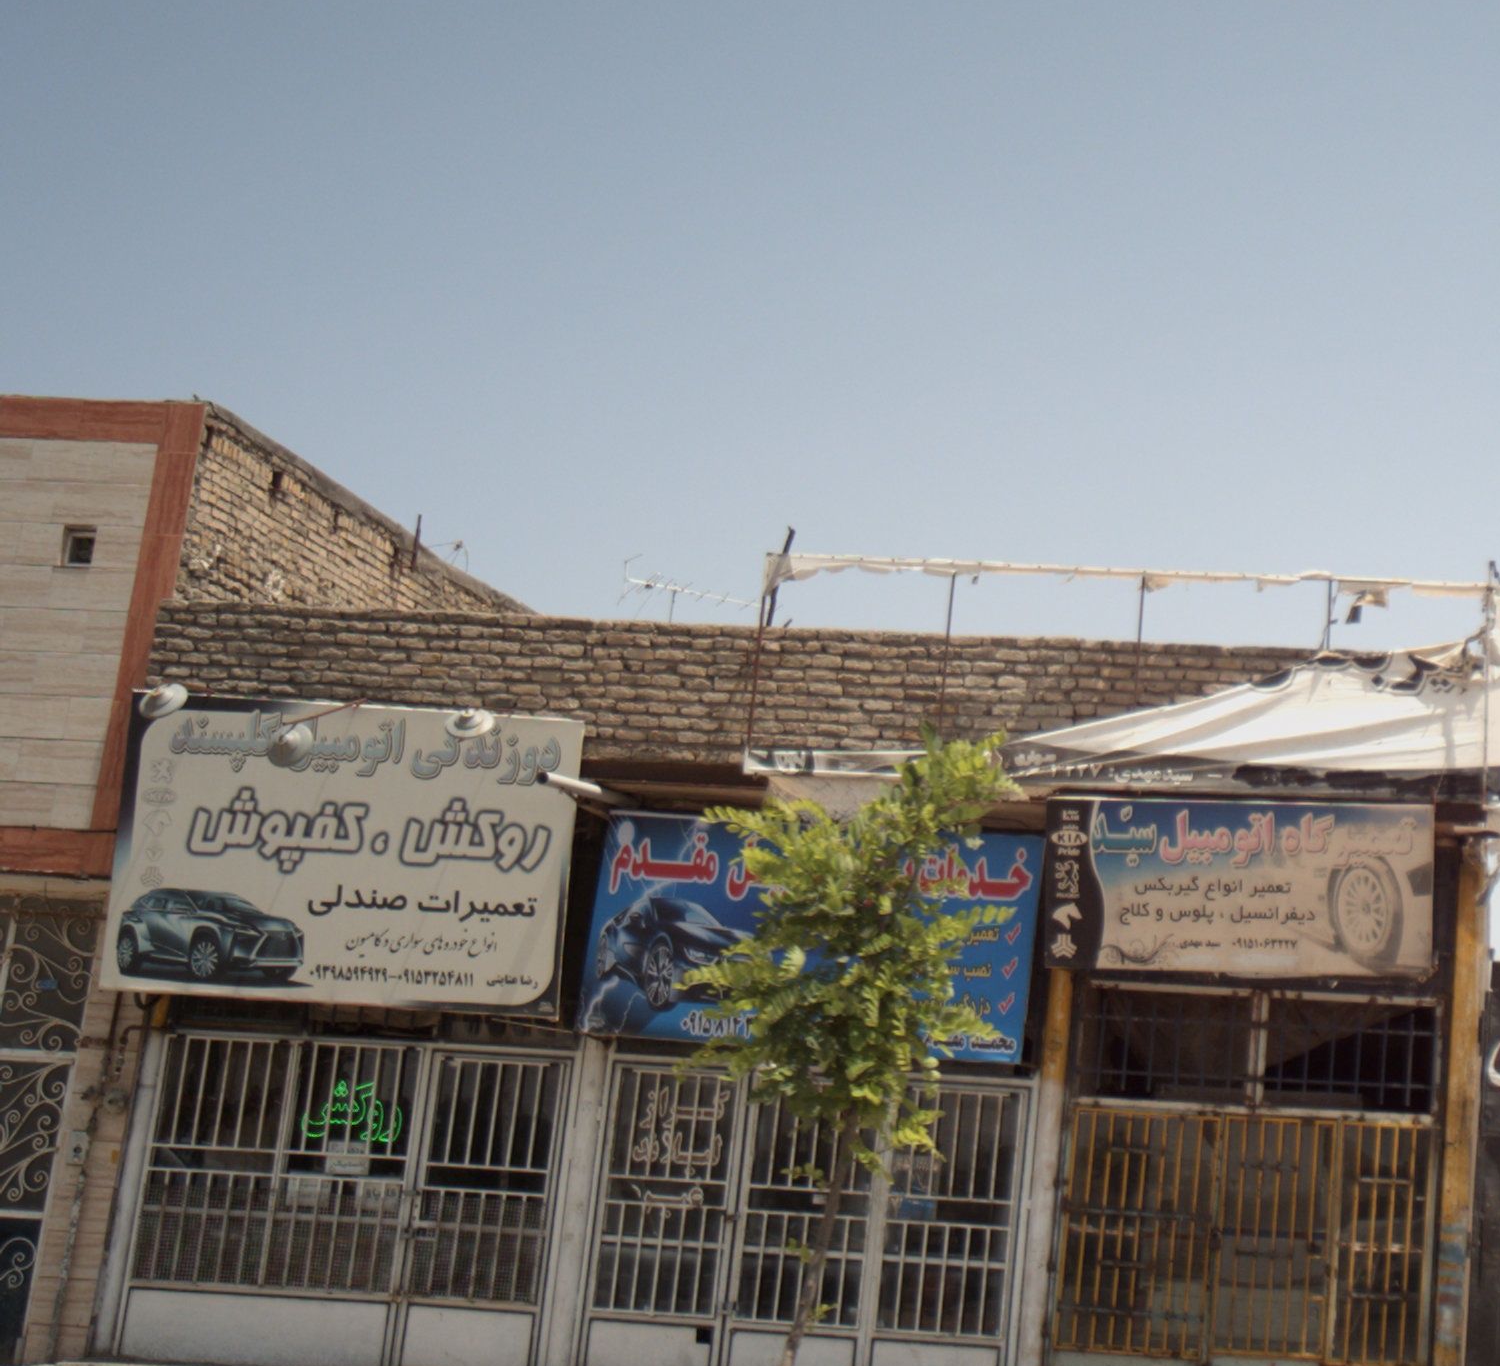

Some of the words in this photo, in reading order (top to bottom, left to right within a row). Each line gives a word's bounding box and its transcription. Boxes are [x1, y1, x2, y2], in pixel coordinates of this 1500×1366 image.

[186, 786, 370, 874] کفپوش
[399, 796, 552, 873] روکش
[1056, 833, 1084, 845] KIA
[1159, 808, 1275, 868] اتومبیل
[1057, 846, 1081, 857] Pride
[609, 831, 719, 894] مقدم
[1134, 876, 1200, 897] گیربکس
[1204, 878, 1243, 900] انواع
[1249, 881, 1291, 899] تعمیر
[308, 883, 408, 917] صندلی
[418, 889, 538, 922] تعمیرات
[1155, 907, 1164, 922] و
[1169, 904, 1215, 925] پلوس
[1230, 905, 1316, 925] دیفرانسیل
[468, 931, 498, 958] انواع
[520, 974, 539, 990] رضا
[963, 963, 992, 982] نصب
[301, 1081, 402, 1143] روکش
